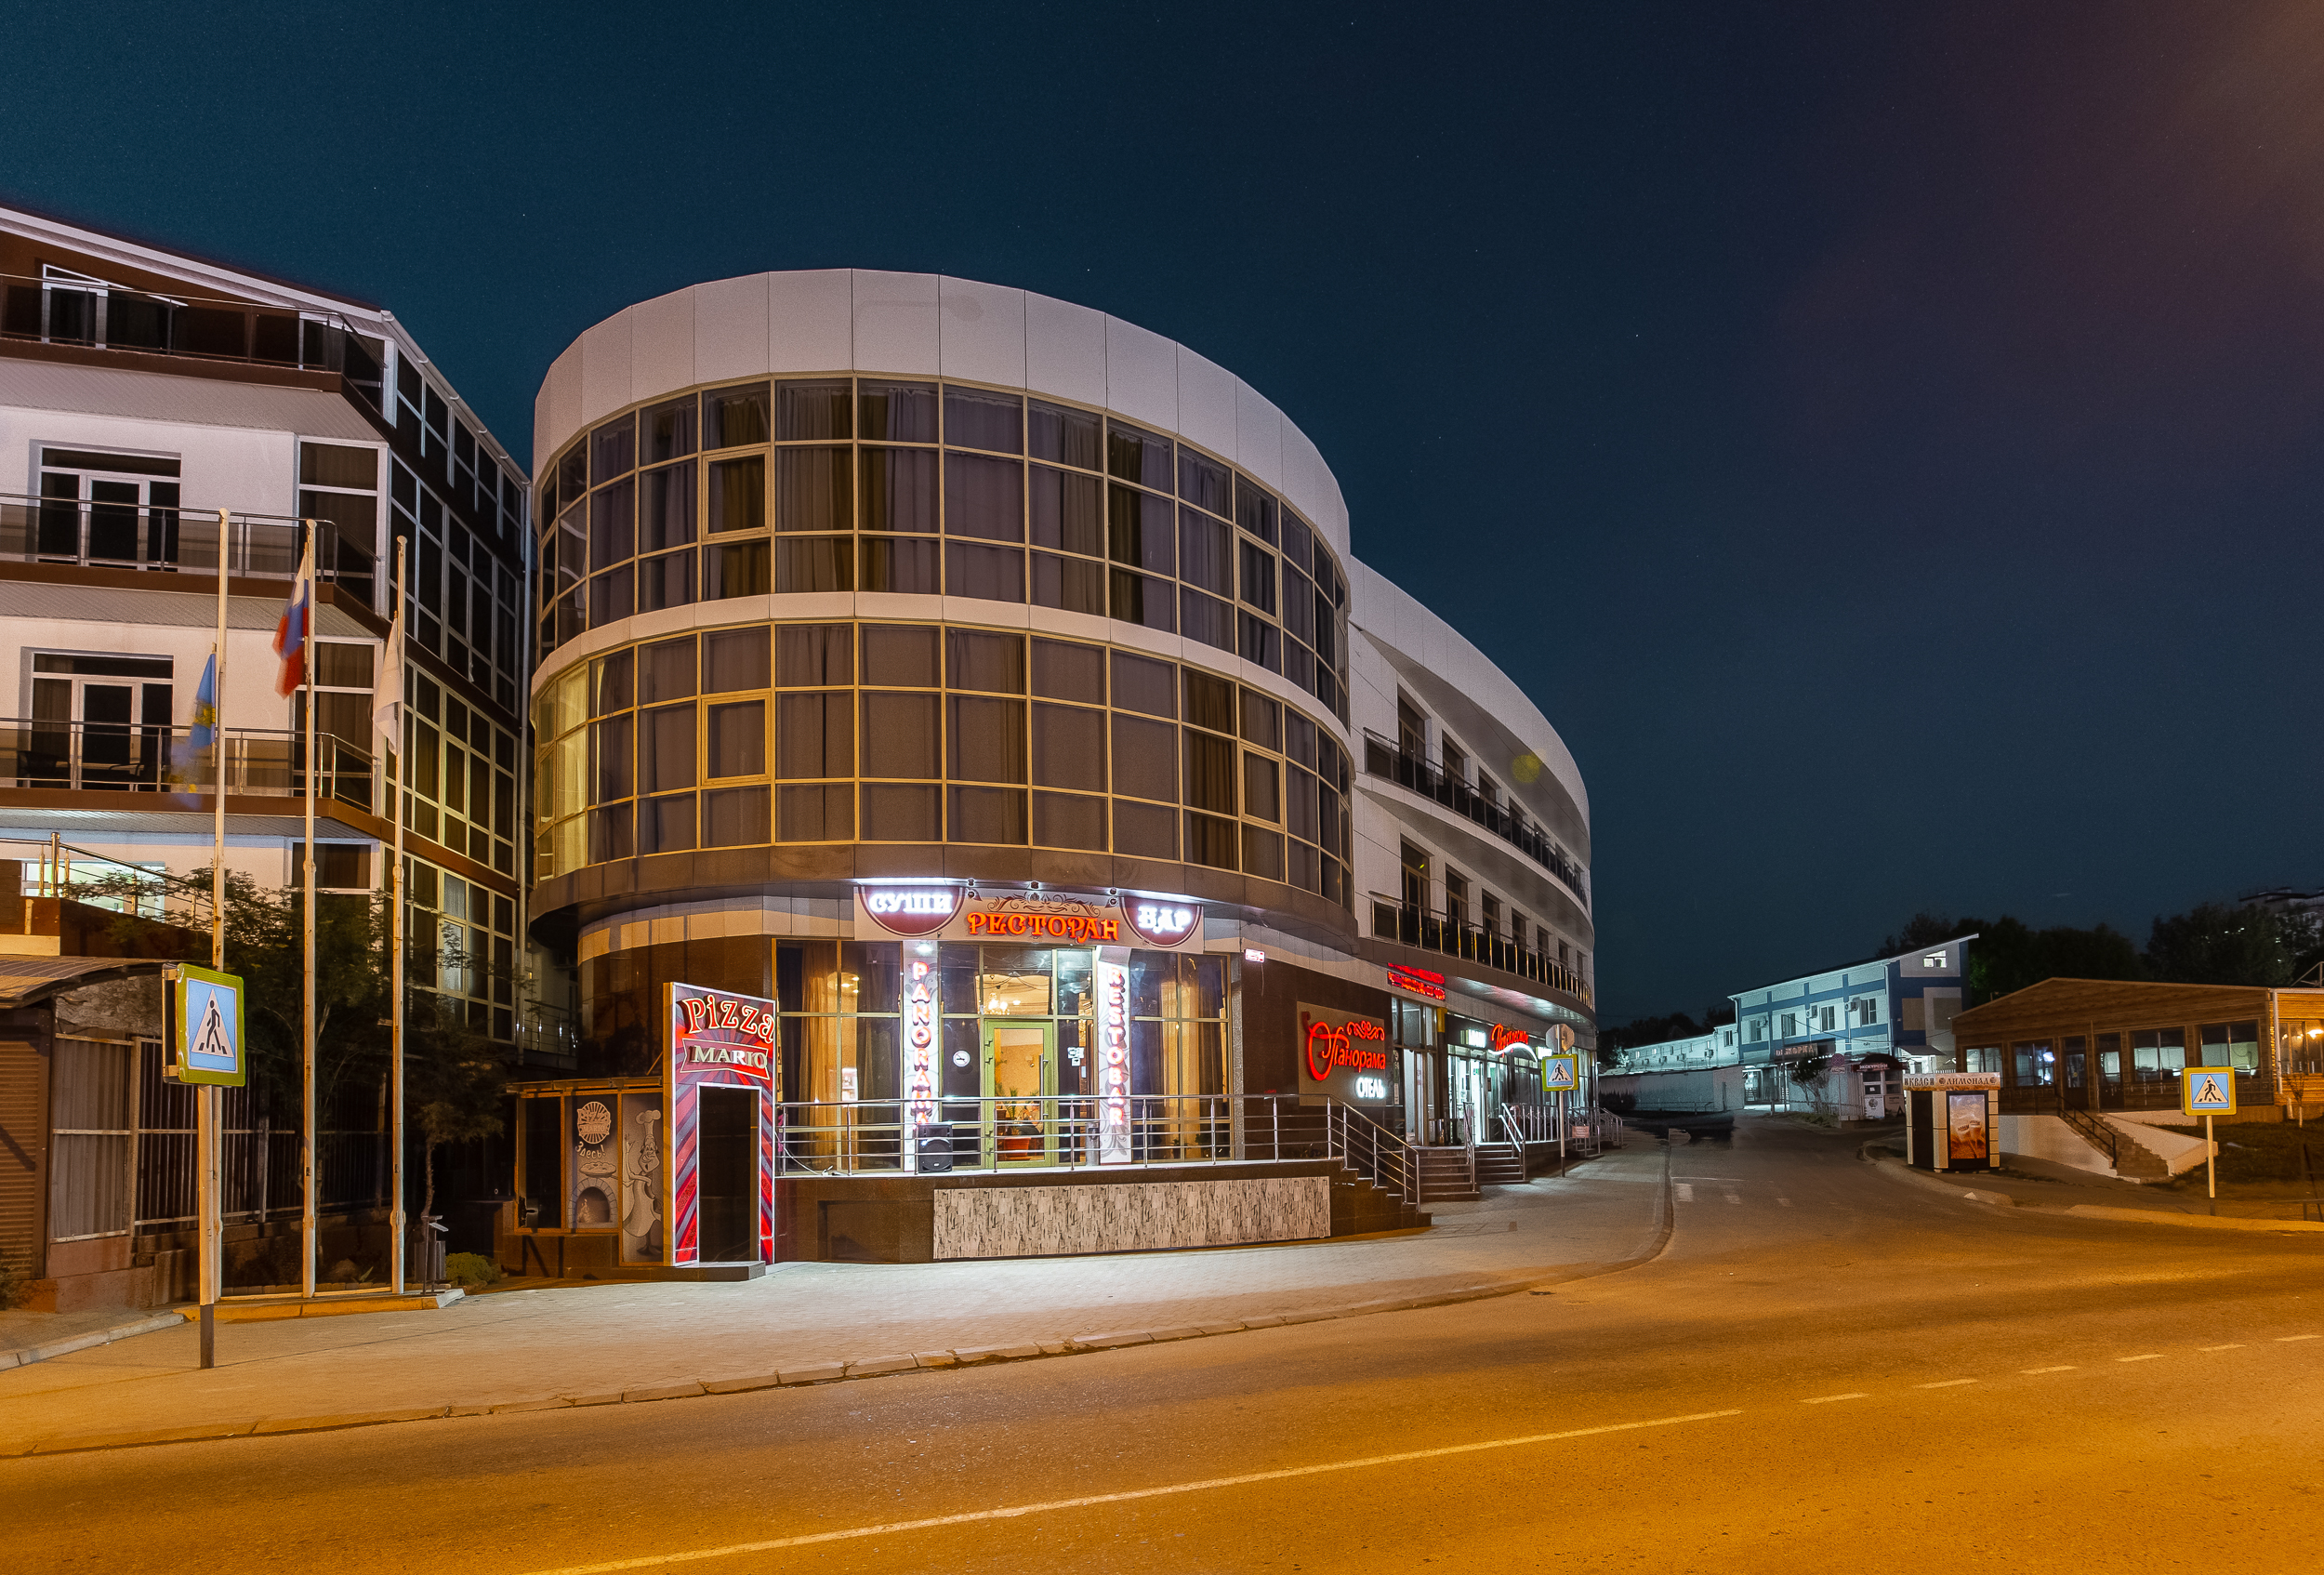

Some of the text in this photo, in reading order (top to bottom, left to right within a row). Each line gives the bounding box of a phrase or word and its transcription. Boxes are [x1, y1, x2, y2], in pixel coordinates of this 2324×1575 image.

[868, 893, 953, 914] СУШИ
[967, 911, 1120, 943] РЕСТОРАН
[1138, 906, 1193, 934] БАР
[681, 995, 775, 1043] Pizza
[690, 1045, 768, 1069] MARIO
[910, 961, 932, 1125] PANORAMA
[1106, 967, 1125, 1125] RESTOBAR
[1356, 1077, 1385, 1099] ОТЕЛЬ
[575, 1141, 606, 1159] Здесь!
